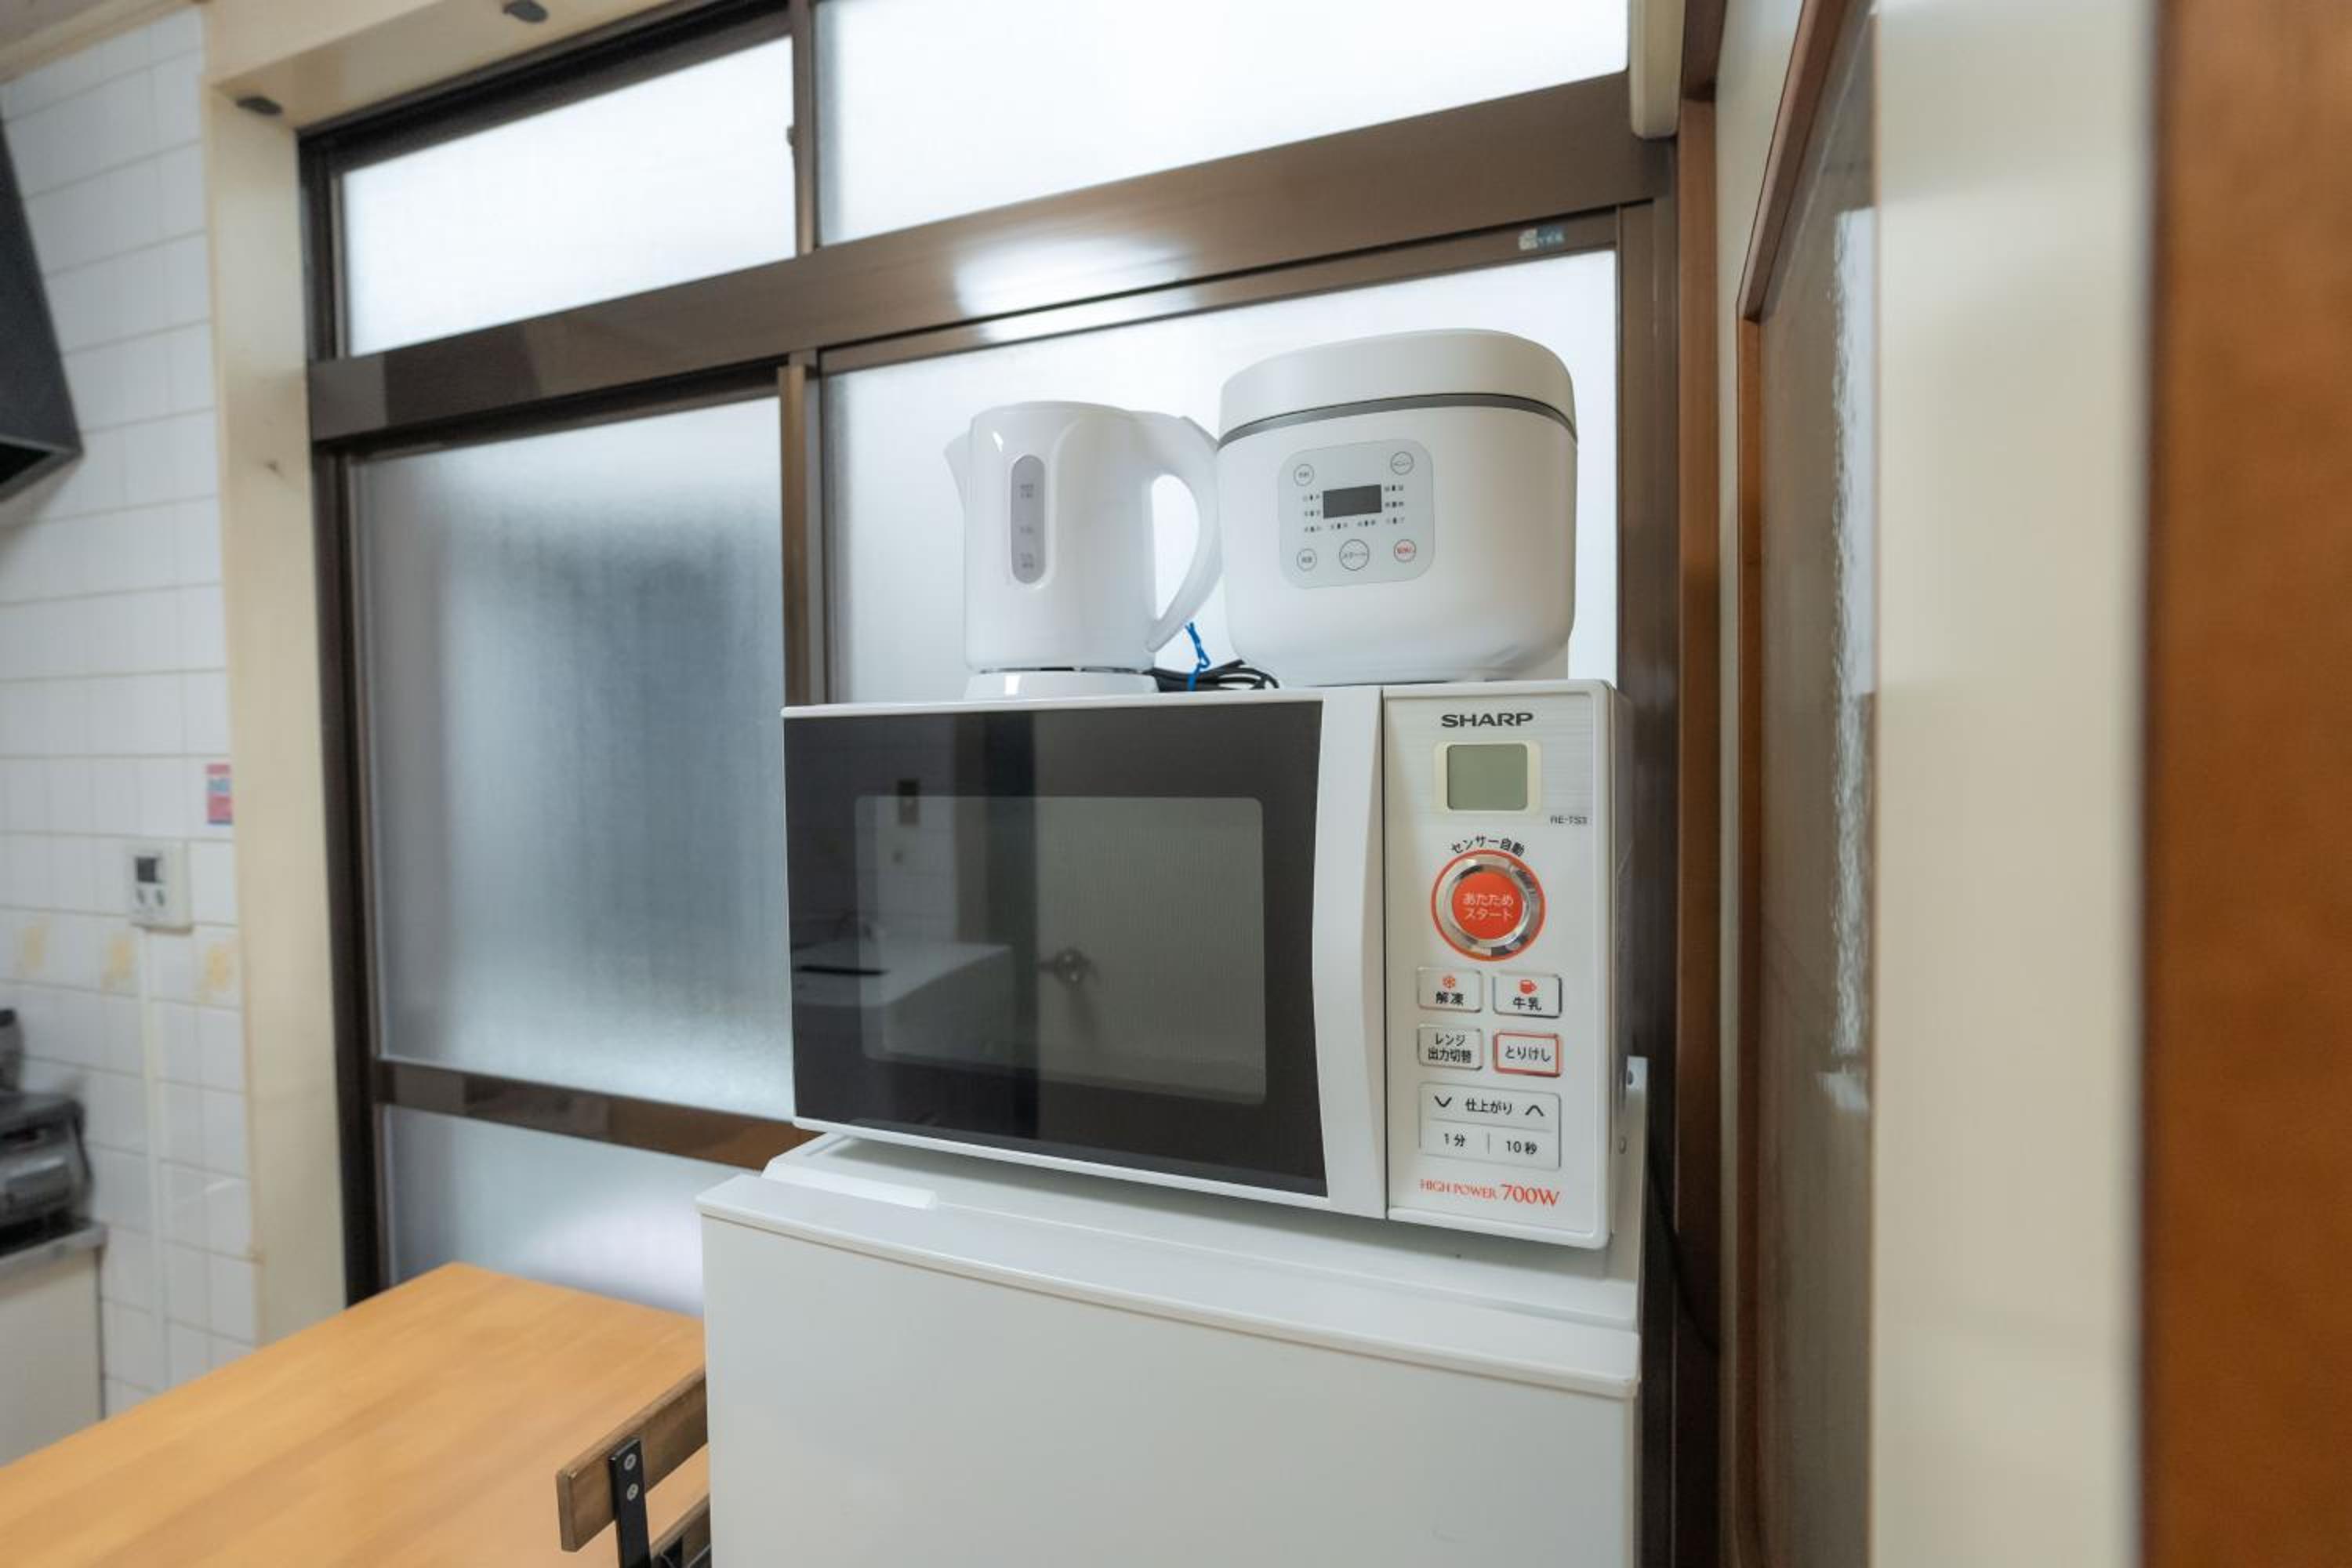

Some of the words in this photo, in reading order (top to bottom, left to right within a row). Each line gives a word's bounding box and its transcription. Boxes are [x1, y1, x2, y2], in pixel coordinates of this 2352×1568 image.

[1441, 712, 1534, 728] SHARP
[1451, 836, 1525, 857] センサー自動
[1463, 892, 1514, 906] あたため
[1465, 908, 1513, 922] スタート
[1436, 991, 1465, 1006] 解凍
[1513, 996, 1542, 1011] 牛乳
[1435, 1033, 1466, 1047] レンジ
[1428, 1047, 1472, 1064] 出力切替
[1504, 1045, 1552, 1062] とりけし
[1465, 1098, 1513, 1116] 仕上がり
[1420, 1178, 1450, 1193] HIGH
[1454, 1182, 1497, 1200] POWER
[1500, 1184, 1560, 1207] 700W
